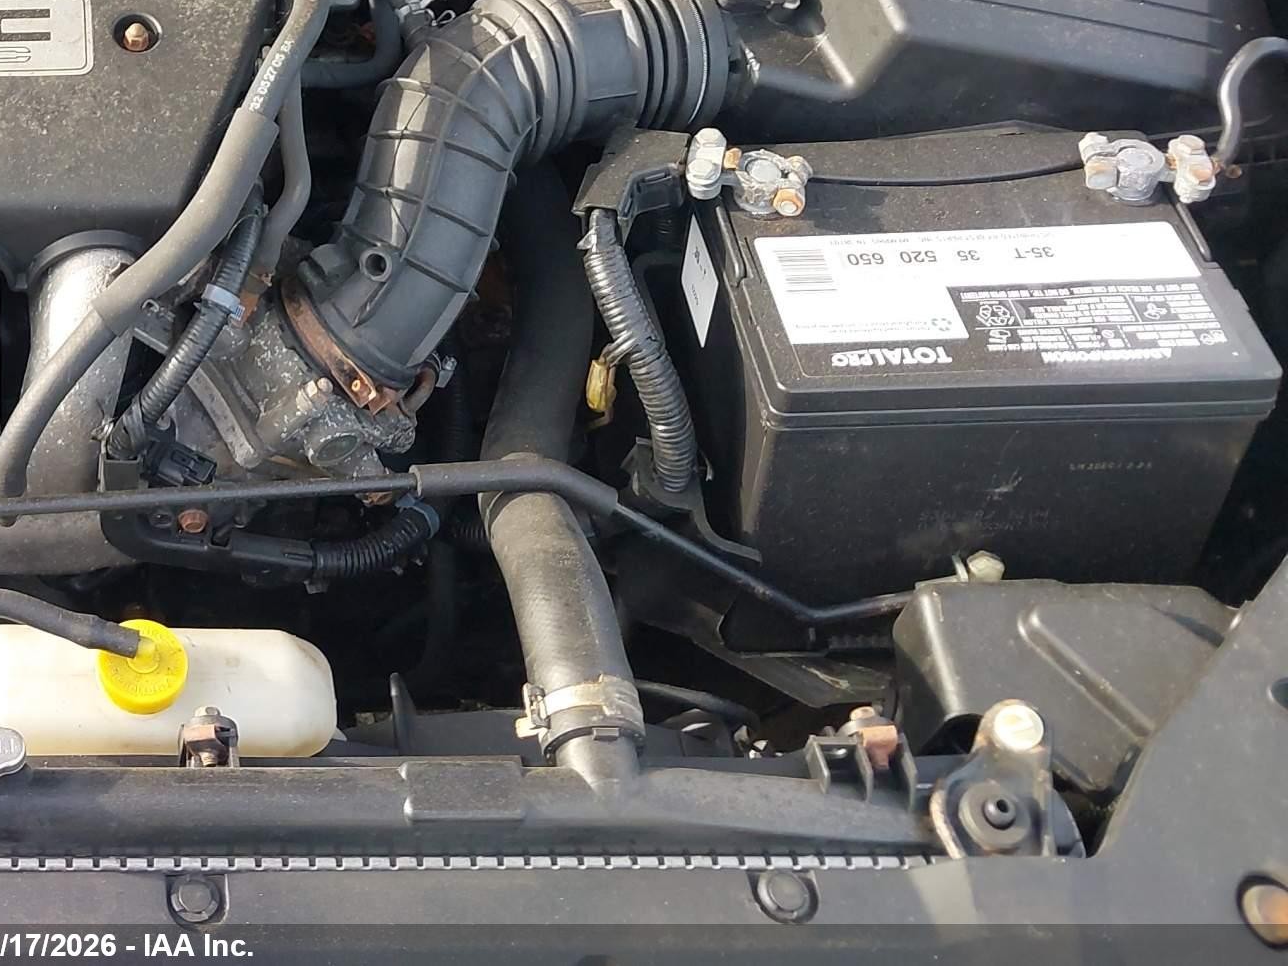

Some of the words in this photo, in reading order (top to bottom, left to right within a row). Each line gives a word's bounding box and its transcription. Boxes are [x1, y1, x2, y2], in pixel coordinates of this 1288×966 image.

[847, 251, 885, 266] 650
[899, 250, 937, 264] 520
[956, 249, 981, 262] 35
[1014, 245, 1055, 260] 35-T
[831, 345, 953, 367] TOTALPRO
